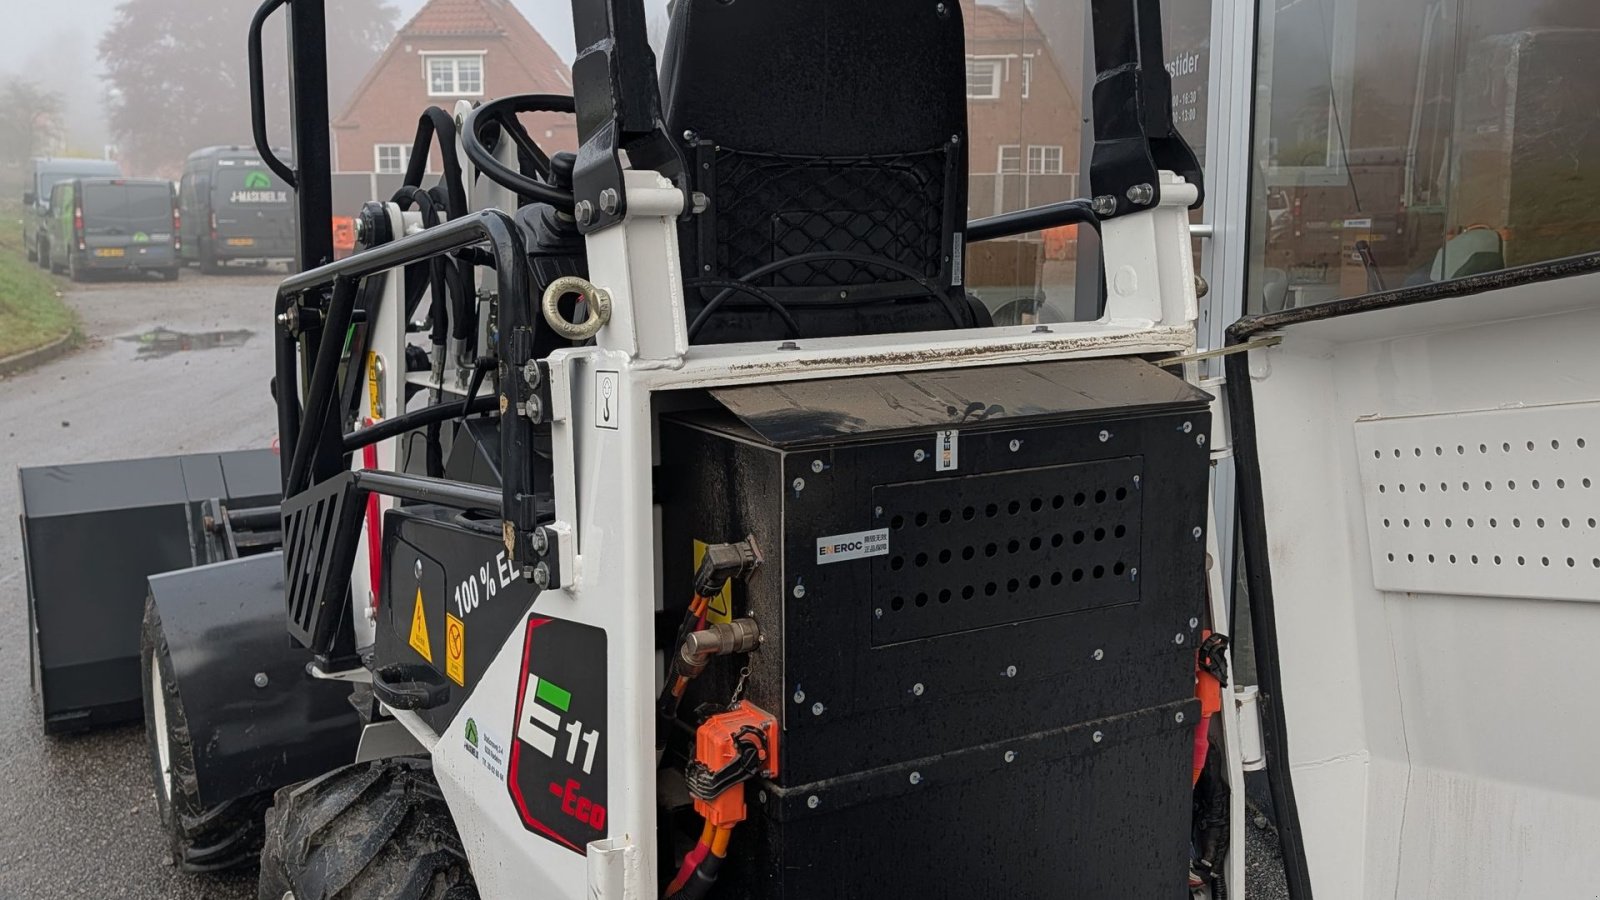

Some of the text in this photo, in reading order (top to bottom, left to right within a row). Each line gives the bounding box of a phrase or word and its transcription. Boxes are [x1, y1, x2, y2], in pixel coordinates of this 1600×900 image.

[819, 541, 863, 556] ENEROC
[454, 575, 480, 618] 100
[480, 561, 497, 601] %
